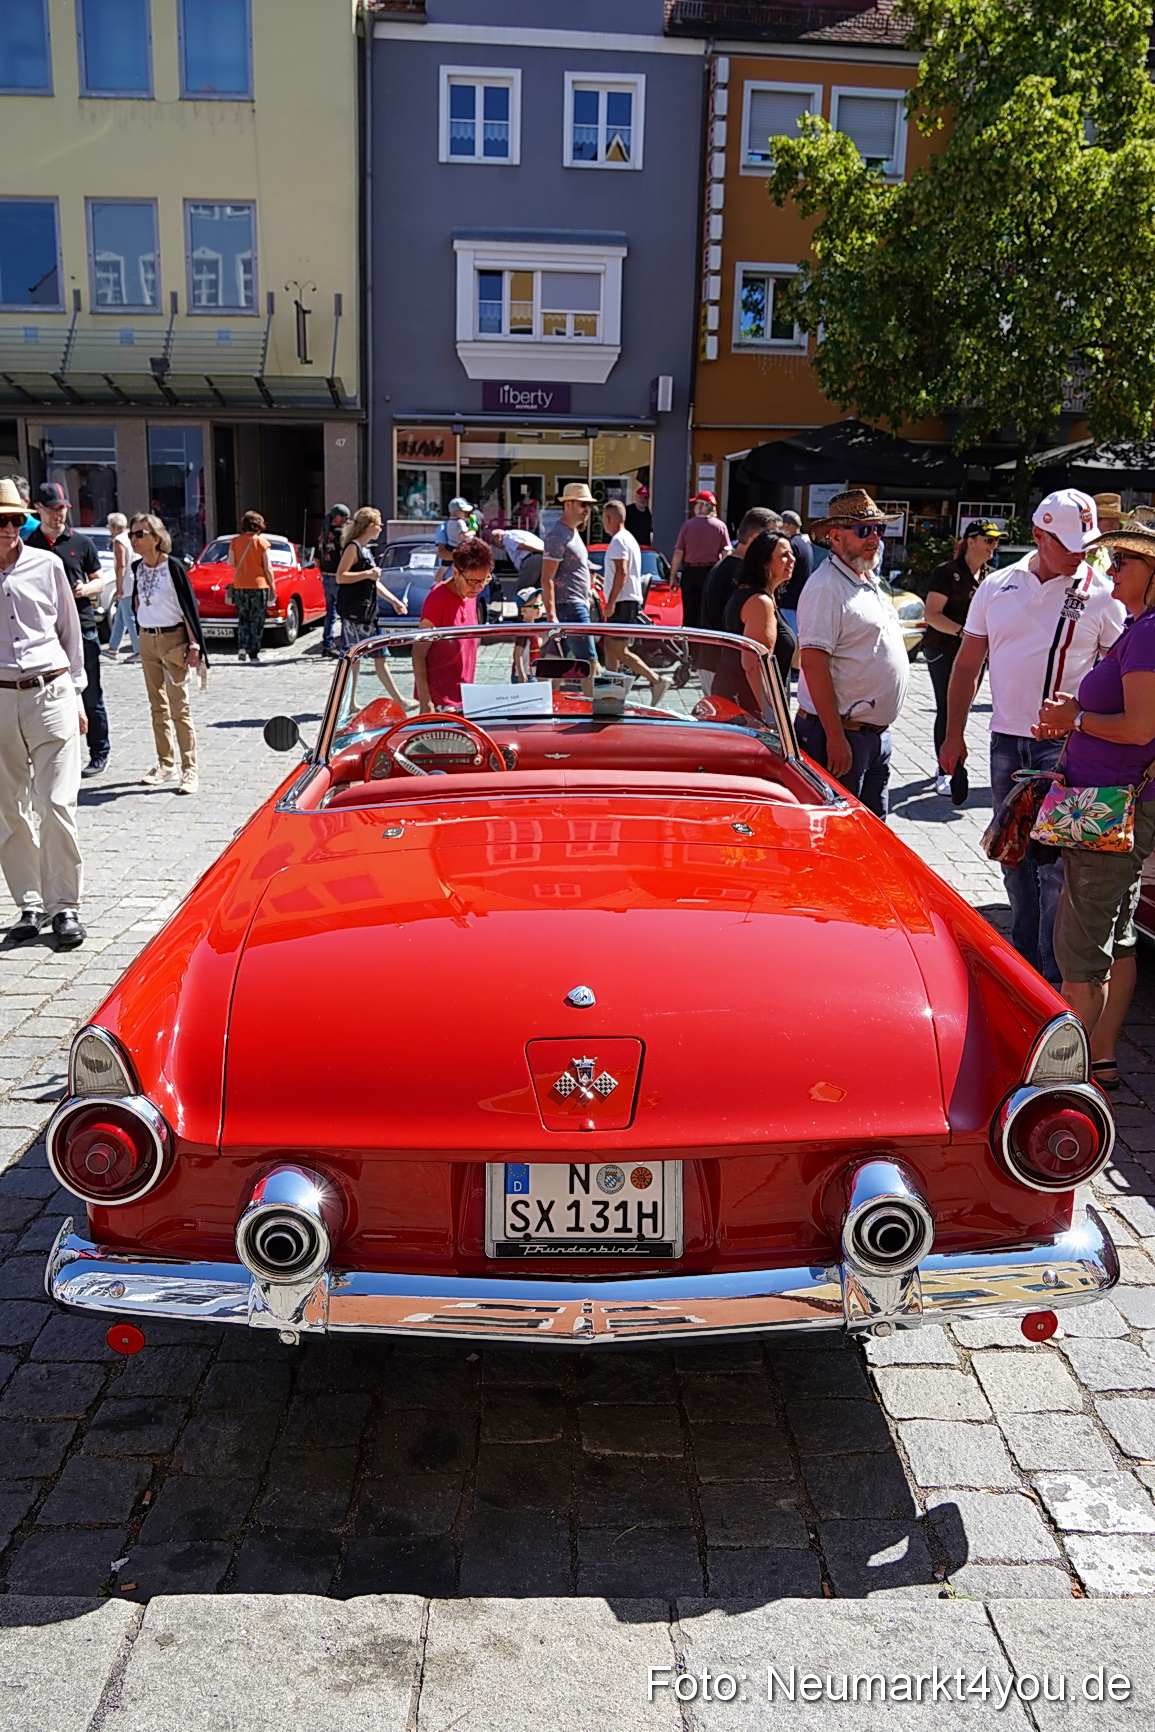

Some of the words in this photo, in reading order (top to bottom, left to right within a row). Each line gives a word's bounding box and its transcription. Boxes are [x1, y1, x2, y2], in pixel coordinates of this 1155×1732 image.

[499, 384, 553, 408] liberty
[336, 438, 346, 448] 47
[593, 444, 606, 475] NEW
[1066, 598, 1082, 609] USA
[513, 1181, 523, 1192] D
[569, 1163, 590, 1194] N
[509, 1200, 555, 1233] SX
[566, 1200, 658, 1233] 131H
[518, 1244, 650, 1256] Thunderbird
